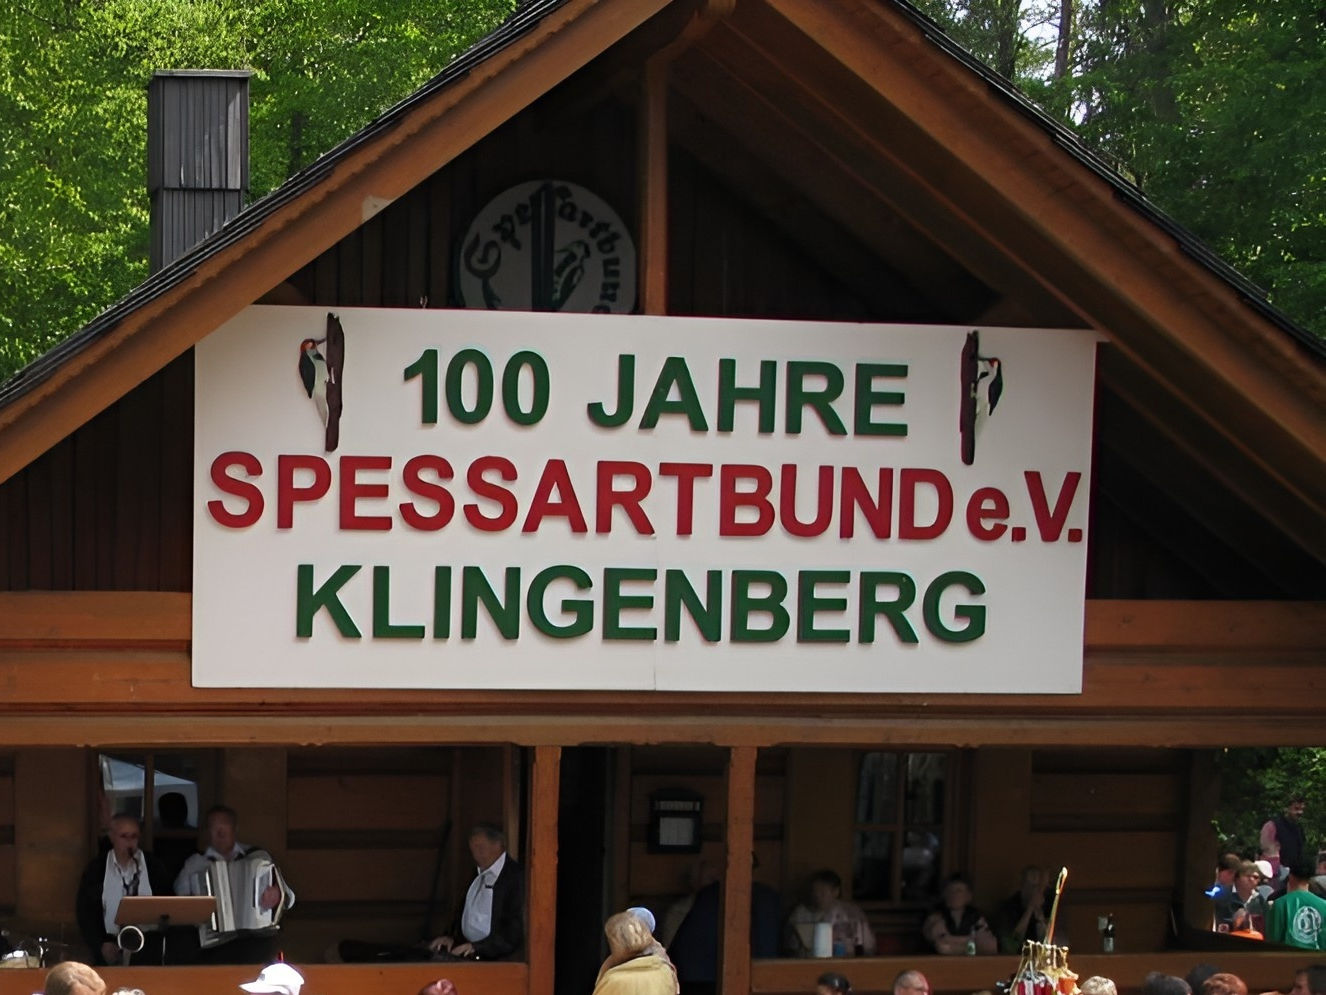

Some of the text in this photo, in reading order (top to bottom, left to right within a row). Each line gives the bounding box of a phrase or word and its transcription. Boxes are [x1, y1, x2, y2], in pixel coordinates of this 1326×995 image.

[403, 347, 911, 438] 100 JAHRE
[207, 452, 1085, 544] SPESSARTBUND e.V.
[295, 562, 988, 646] KLINGENBERG
